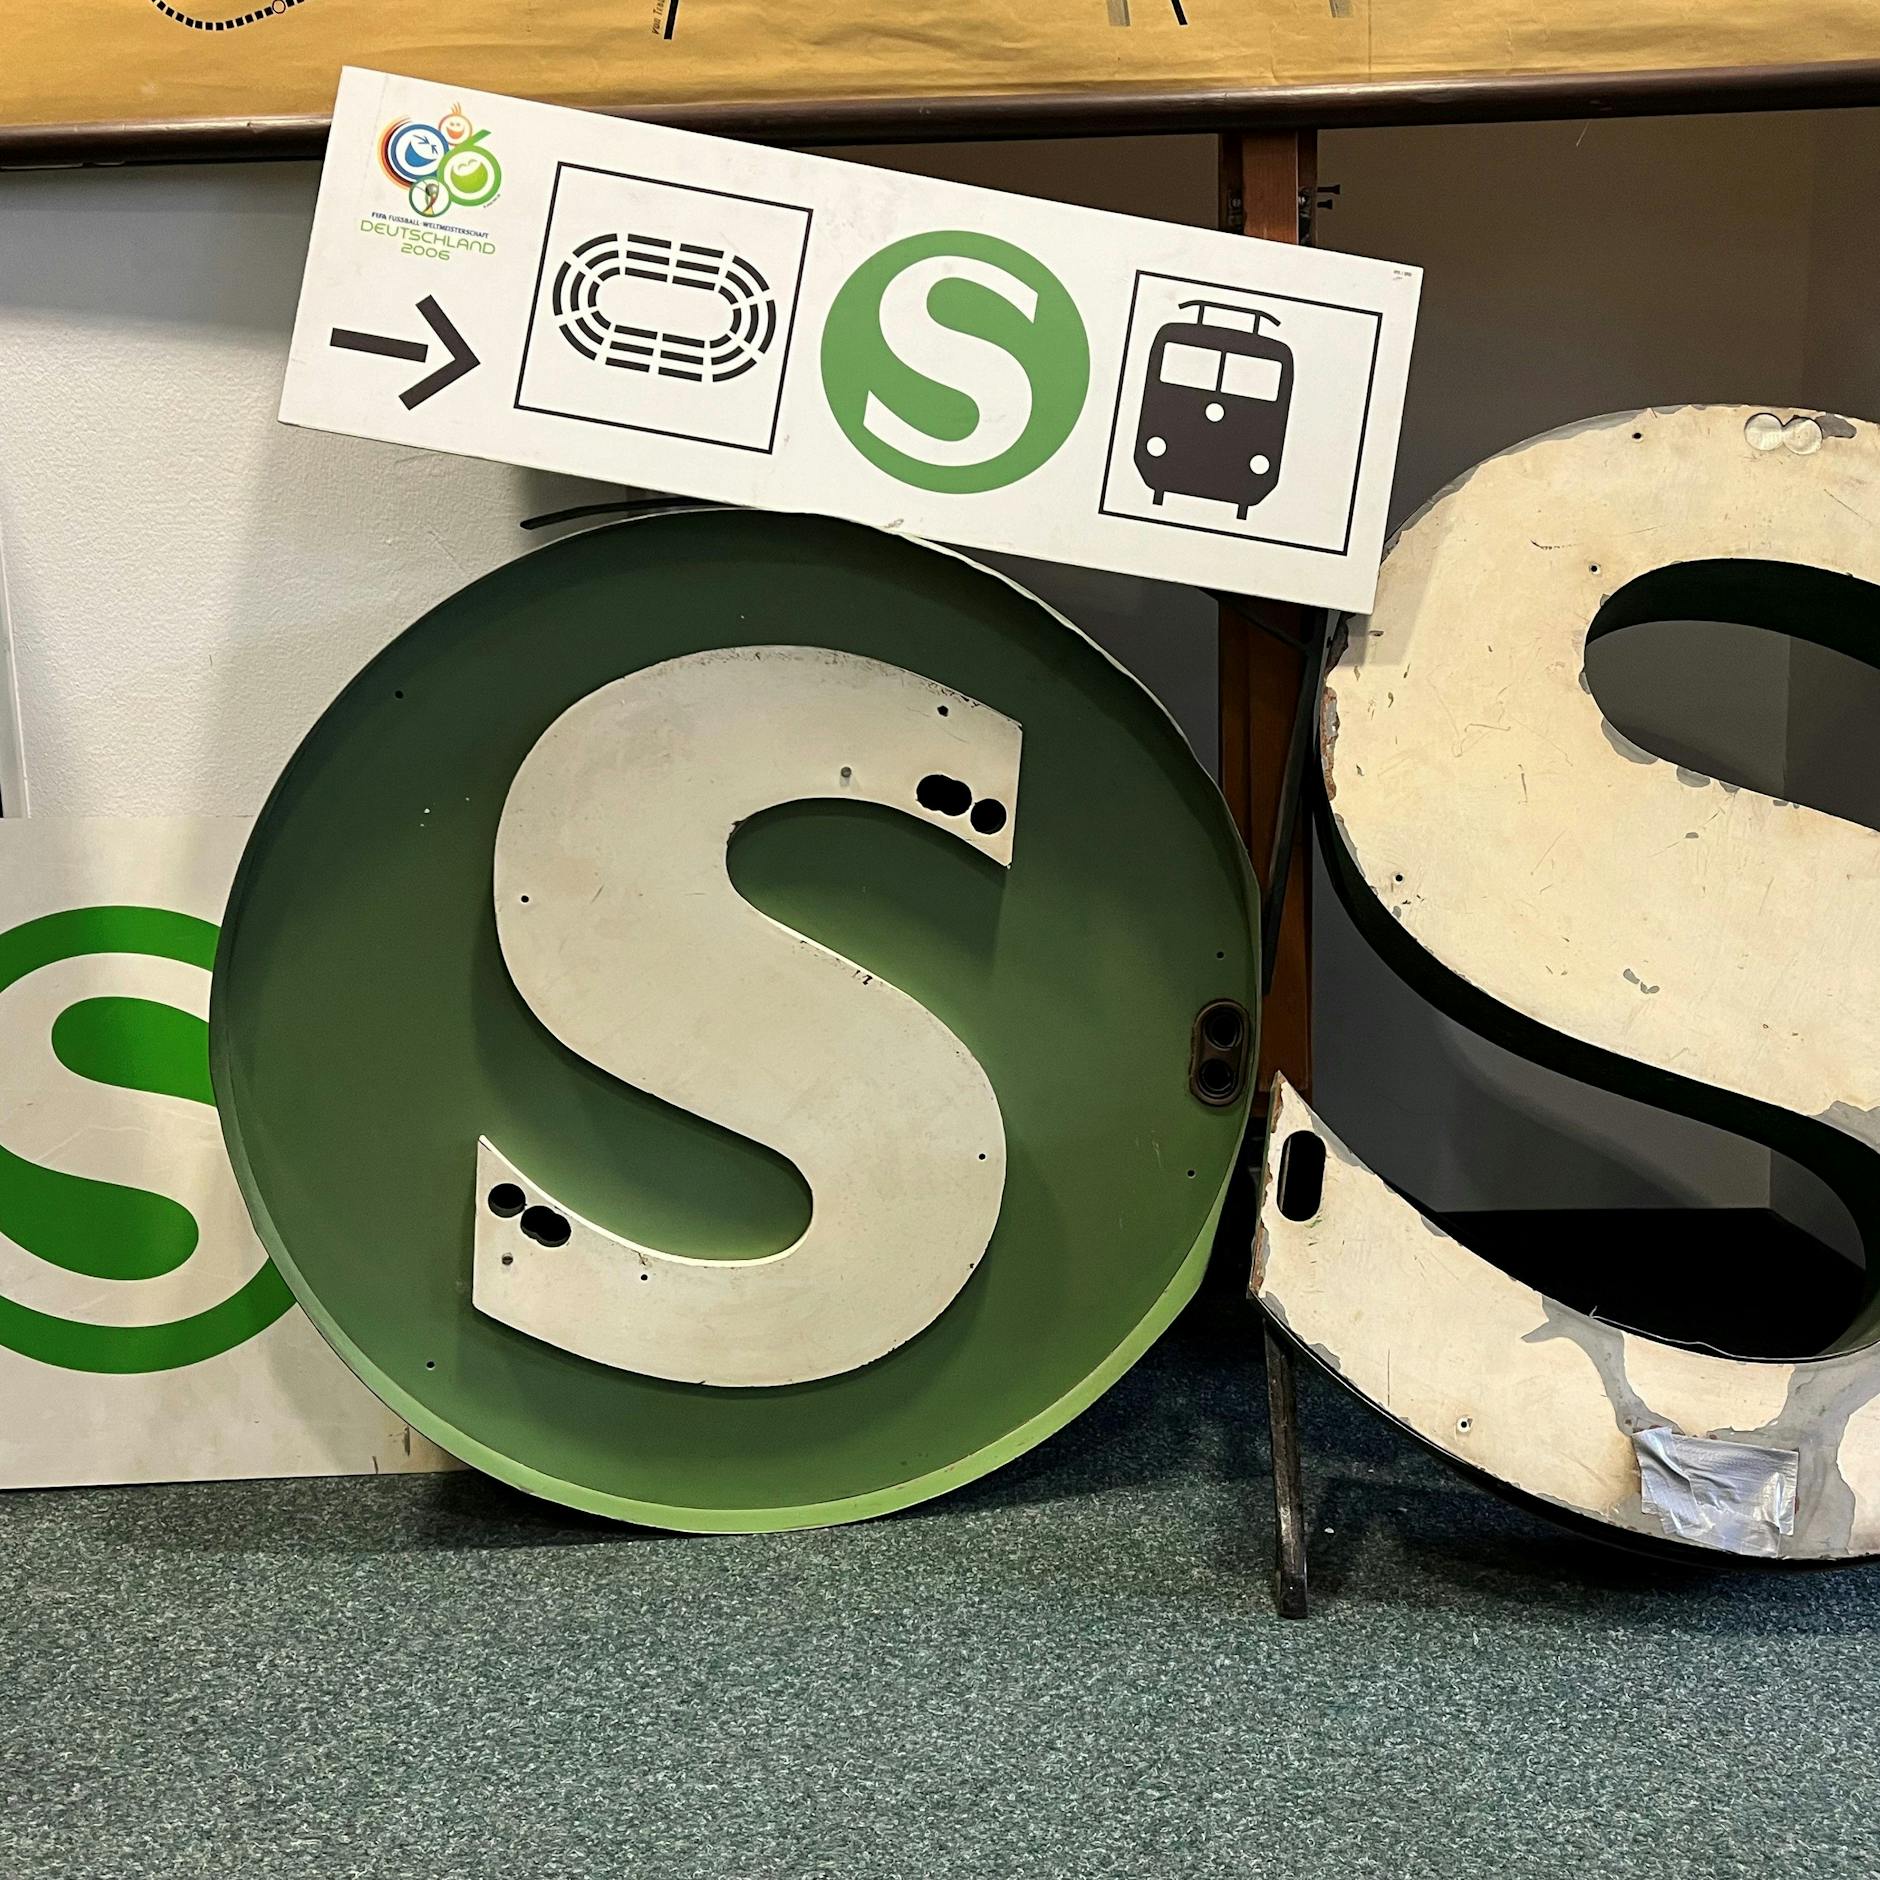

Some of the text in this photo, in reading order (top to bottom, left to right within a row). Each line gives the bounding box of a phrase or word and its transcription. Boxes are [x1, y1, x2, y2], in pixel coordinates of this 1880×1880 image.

[371, 211, 387, 220] FIFA
[360, 219, 496, 255] DEUTSCHLAND
[400, 242, 450, 261] 2006
[863, 255, 1039, 467] S
[472, 644, 1023, 1388] S
